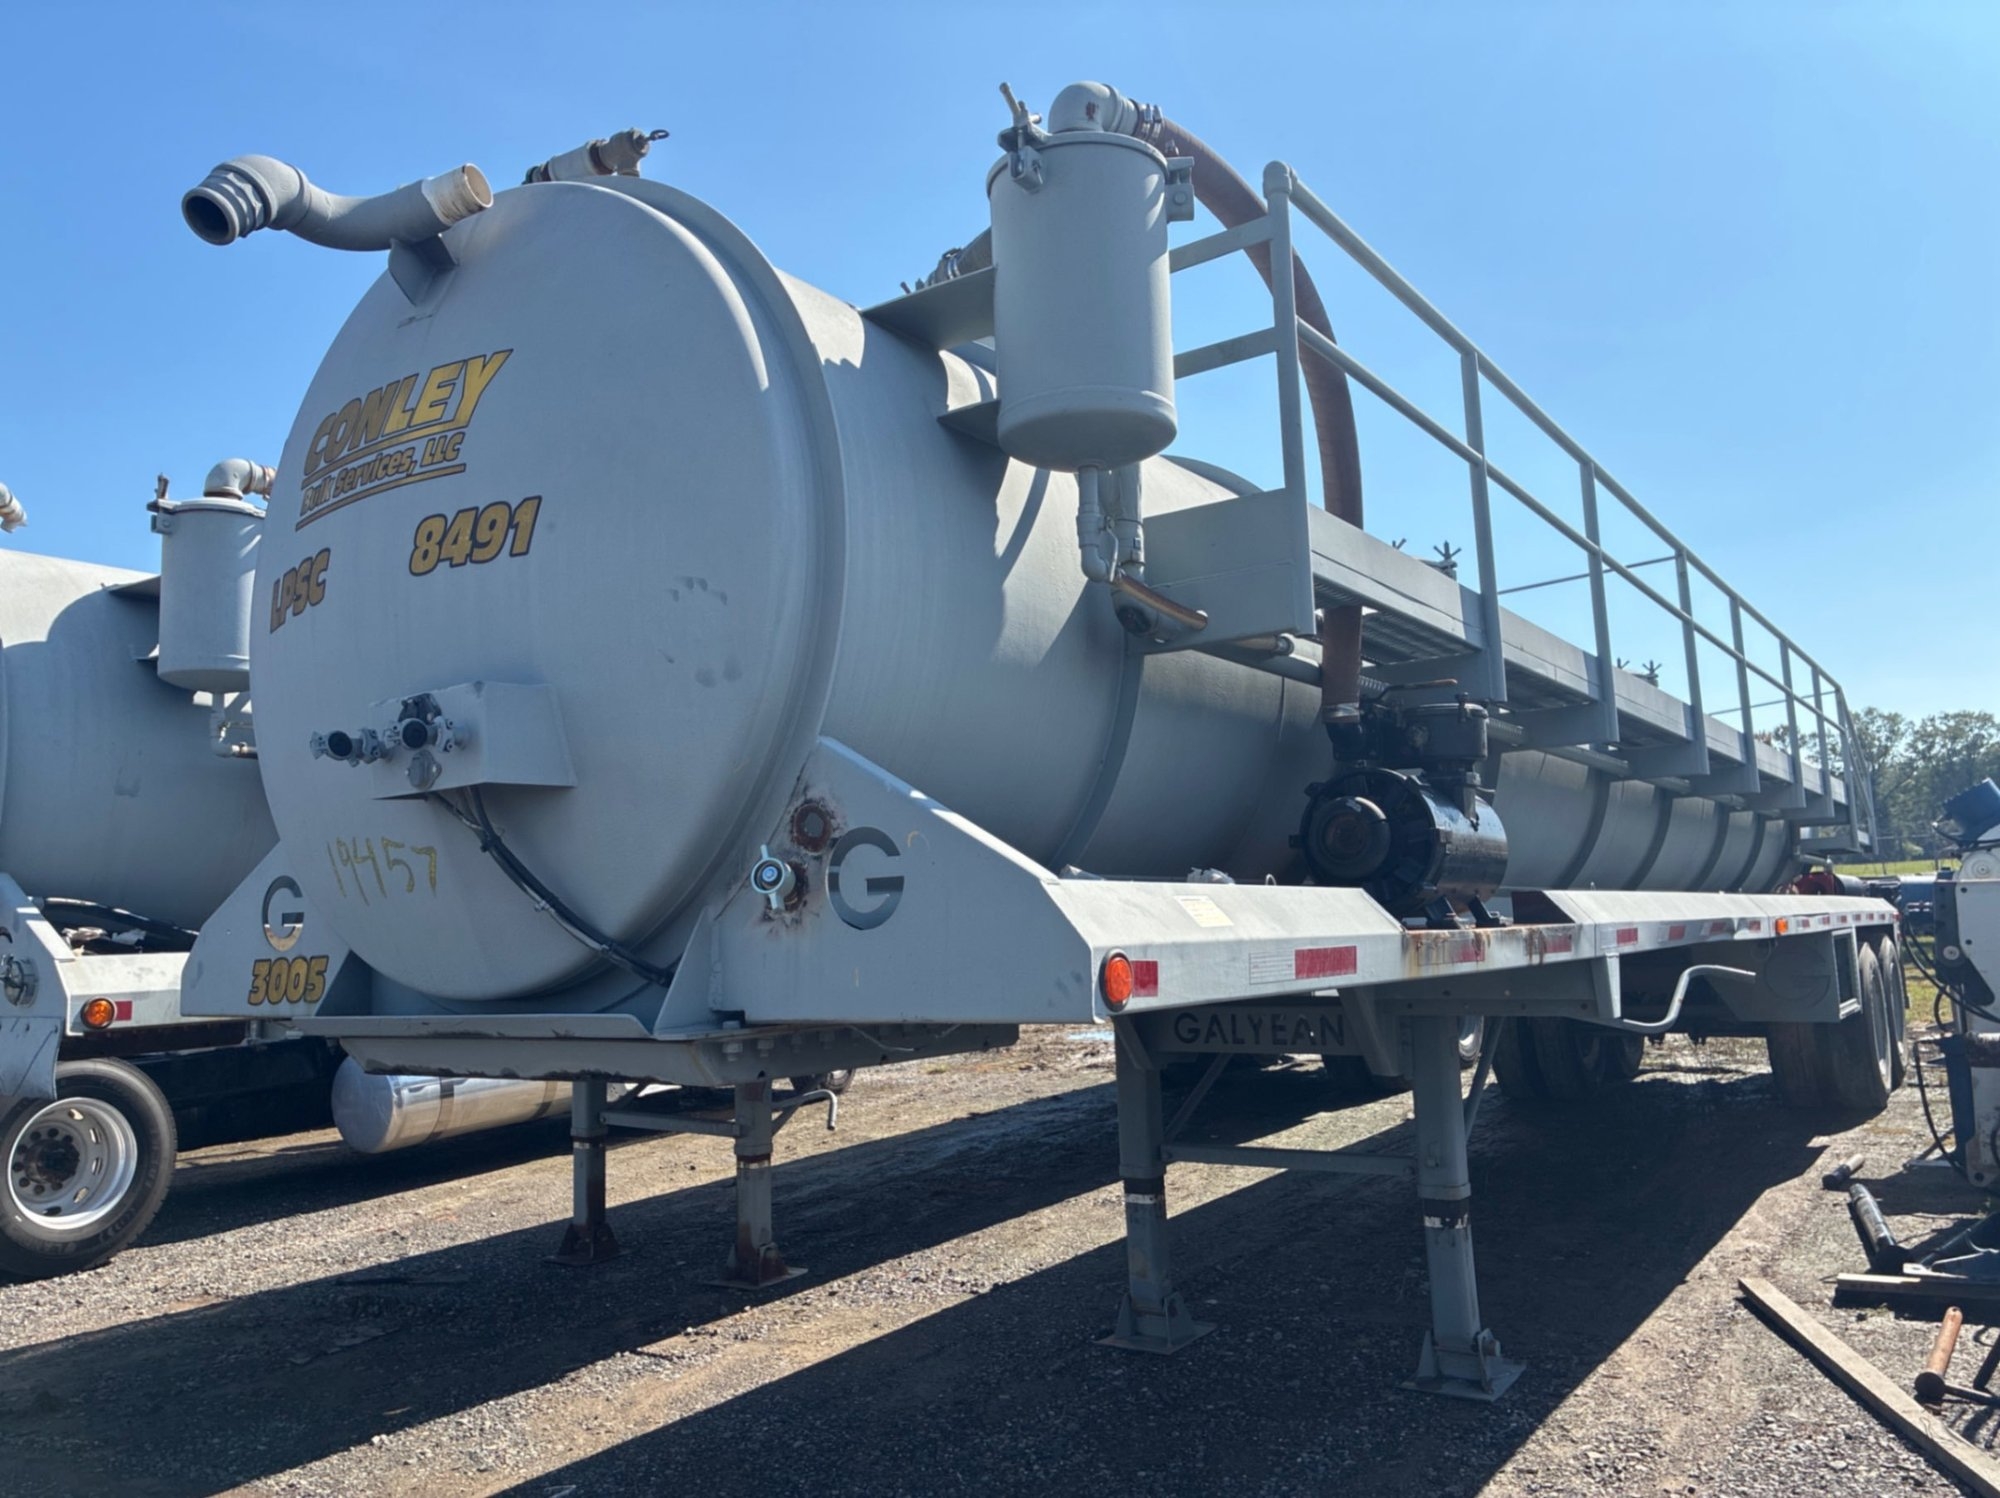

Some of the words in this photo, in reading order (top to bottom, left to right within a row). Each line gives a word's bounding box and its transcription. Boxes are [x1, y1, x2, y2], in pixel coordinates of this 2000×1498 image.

[303, 348, 514, 476] CONLEY
[299, 475, 335, 517] Bulk
[332, 446, 418, 498] Services,
[419, 431, 466, 468] LLC
[409, 495, 542, 577] 8491
[269, 547, 331, 634] LPSC
[261, 875, 305, 951] G
[826, 826, 905, 930] G
[247, 954, 329, 1006] 3005
[1173, 1011, 1345, 1047] GALYEAN
